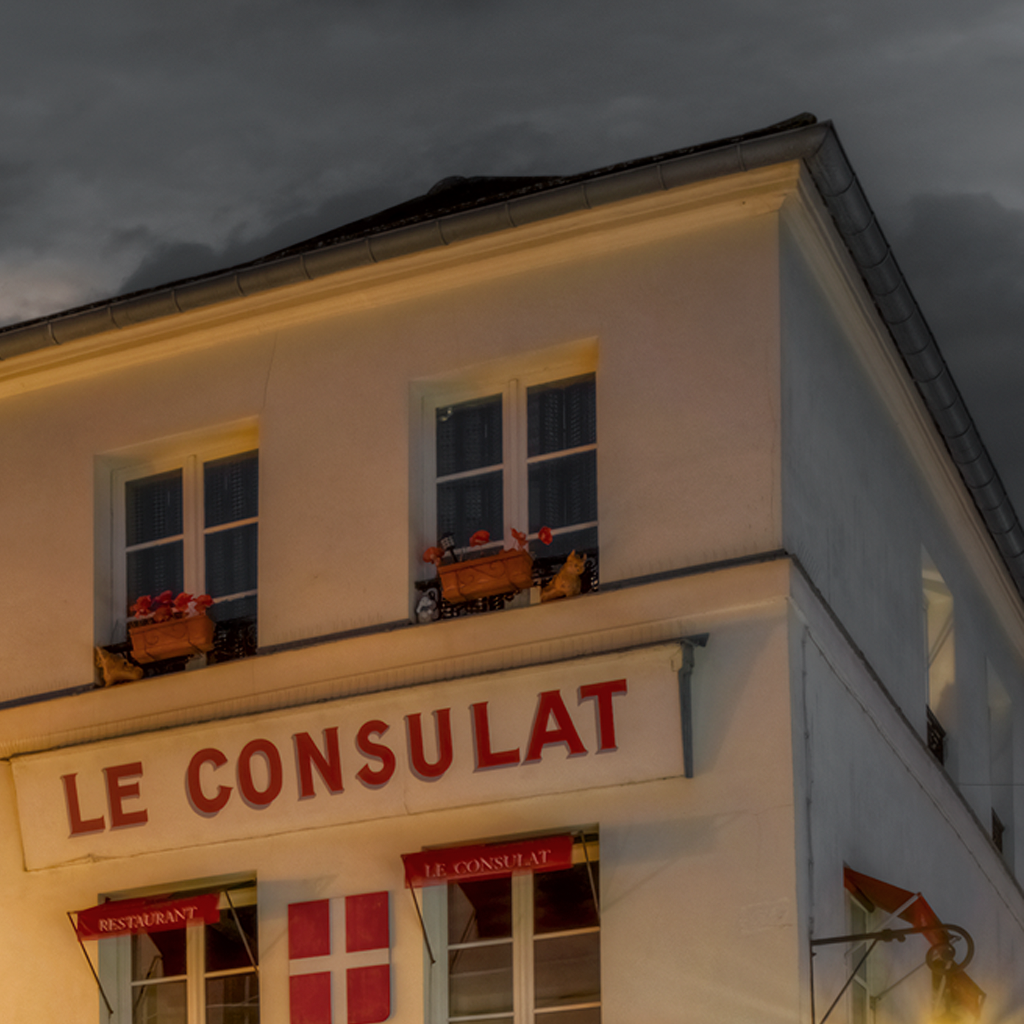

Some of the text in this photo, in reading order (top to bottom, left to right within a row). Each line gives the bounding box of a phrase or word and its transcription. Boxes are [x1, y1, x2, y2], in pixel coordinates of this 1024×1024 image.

[61, 679, 627, 838] LE CONSULAT
[426, 849, 551, 878] LE CONSULAT
[98, 906, 198, 932] RESTAURANT
